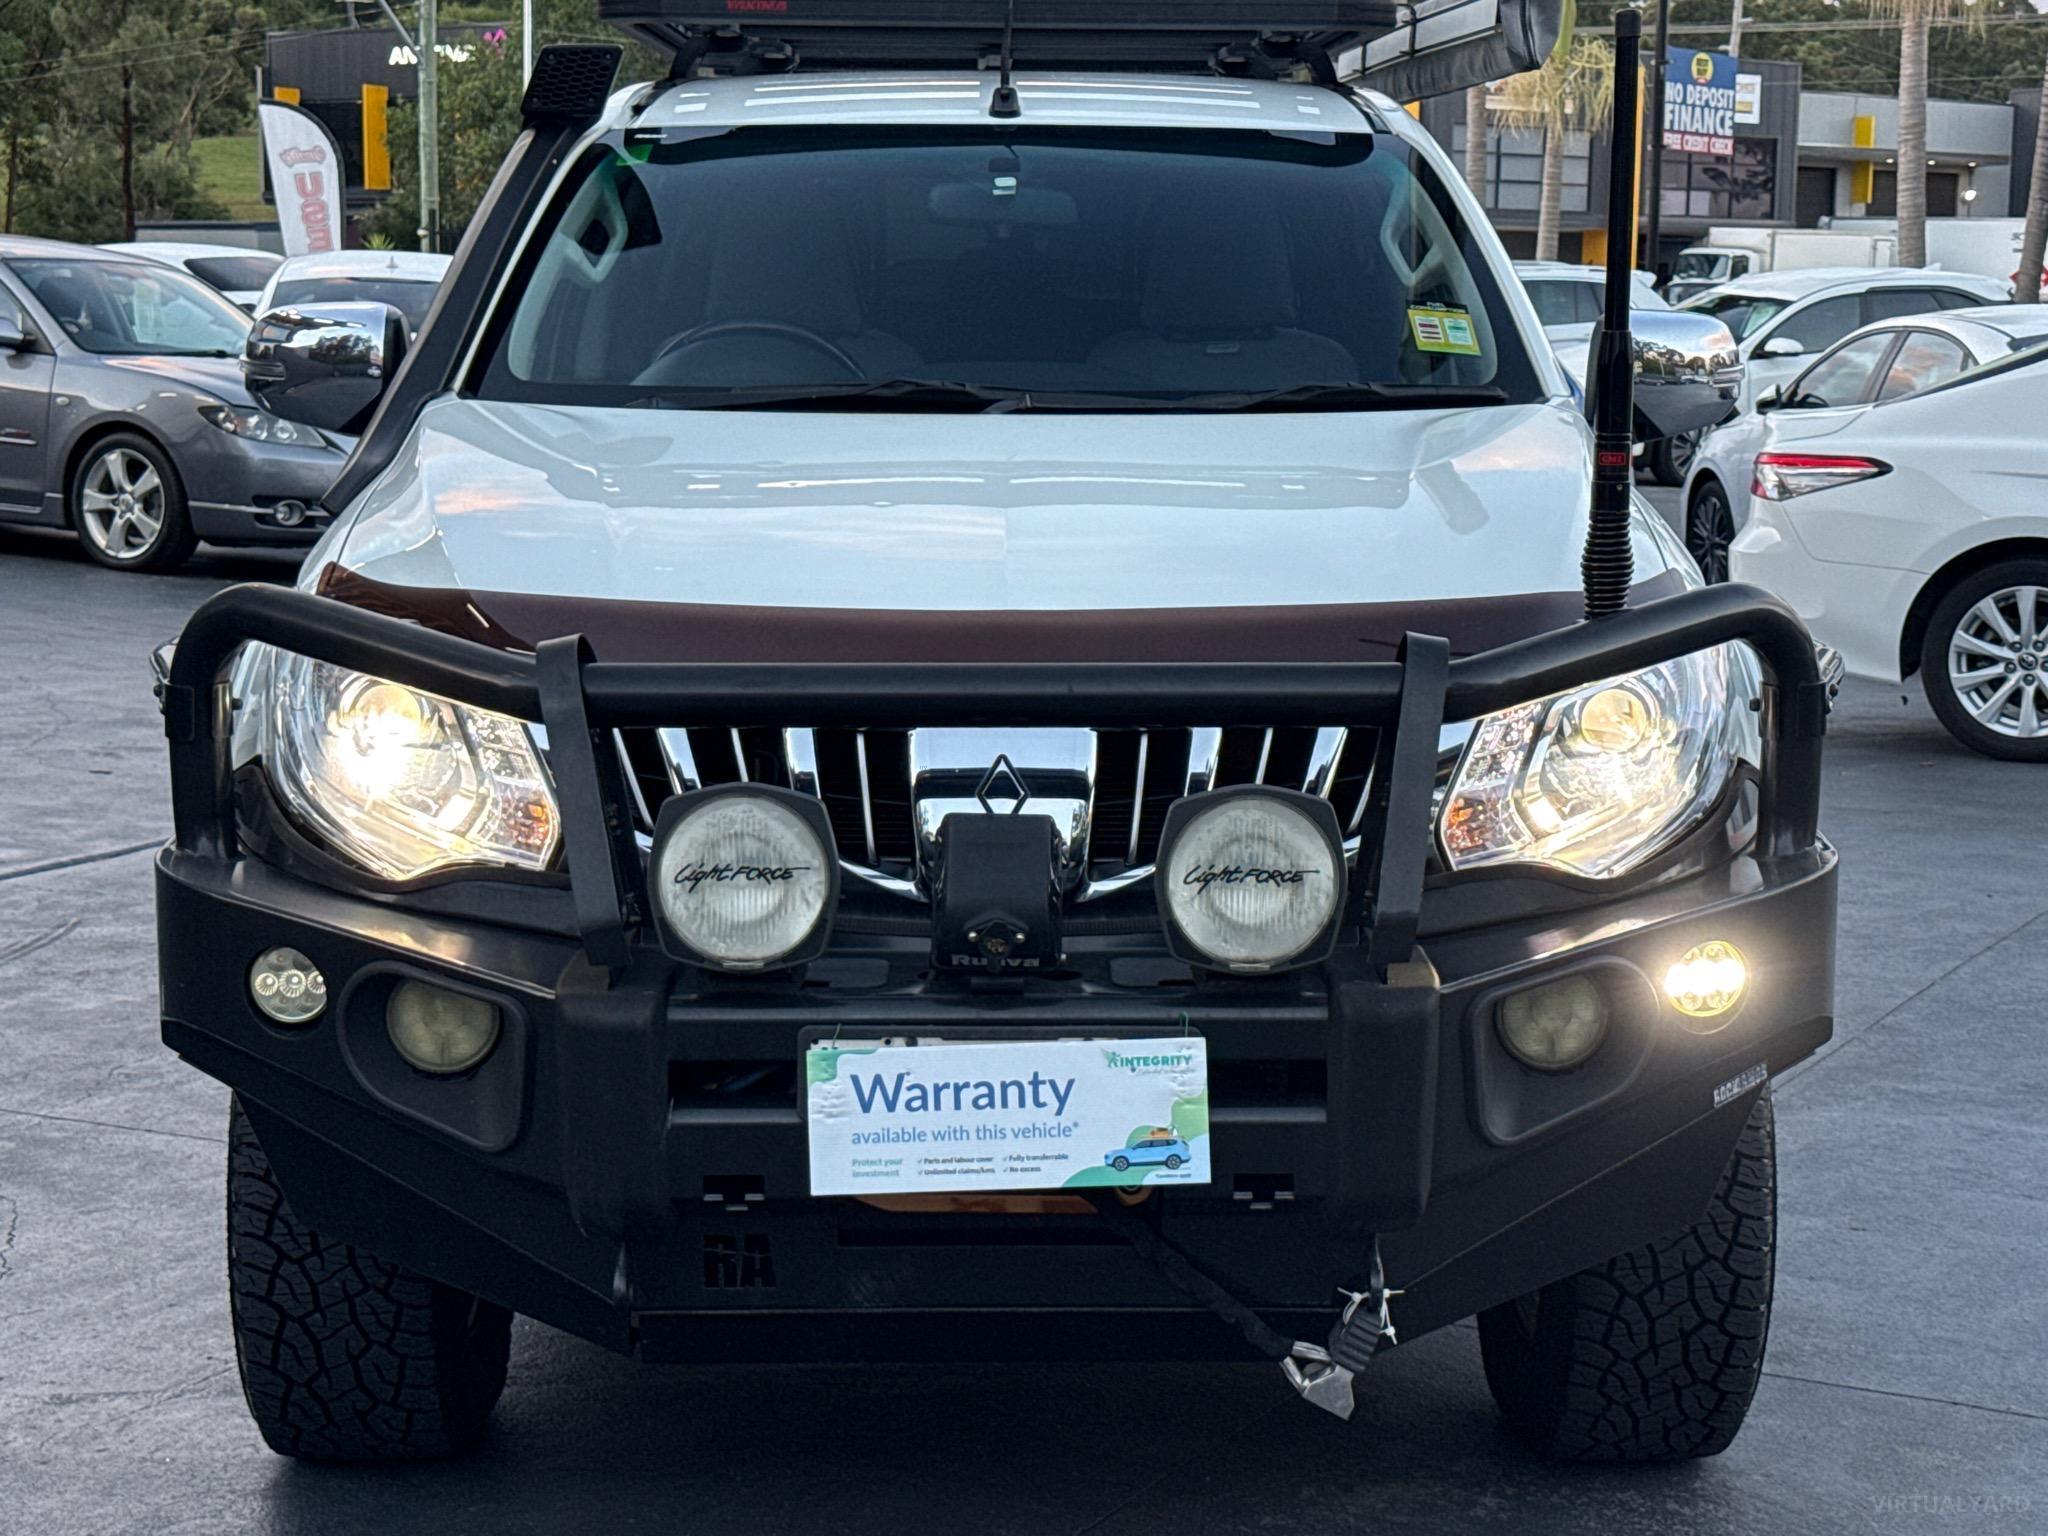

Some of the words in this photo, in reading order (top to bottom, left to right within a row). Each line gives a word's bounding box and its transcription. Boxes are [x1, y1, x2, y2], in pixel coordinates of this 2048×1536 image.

[1665, 80, 1684, 103] NO
[1686, 84, 1735, 110] DEPOSIT
[1664, 102, 1734, 136] FINANCE
[951, 954, 1040, 967] Ruva
[1120, 1055, 1193, 1068] INTEGRITY
[850, 1071, 1076, 1117] Warranty
[851, 1126, 927, 1144] available
[931, 1125, 970, 1142] with
[975, 1124, 1007, 1140] this
[852, 1158, 881, 1167] Protect
[884, 1158, 903, 1167] your
[1009, 1154, 1025, 1162] Fully
